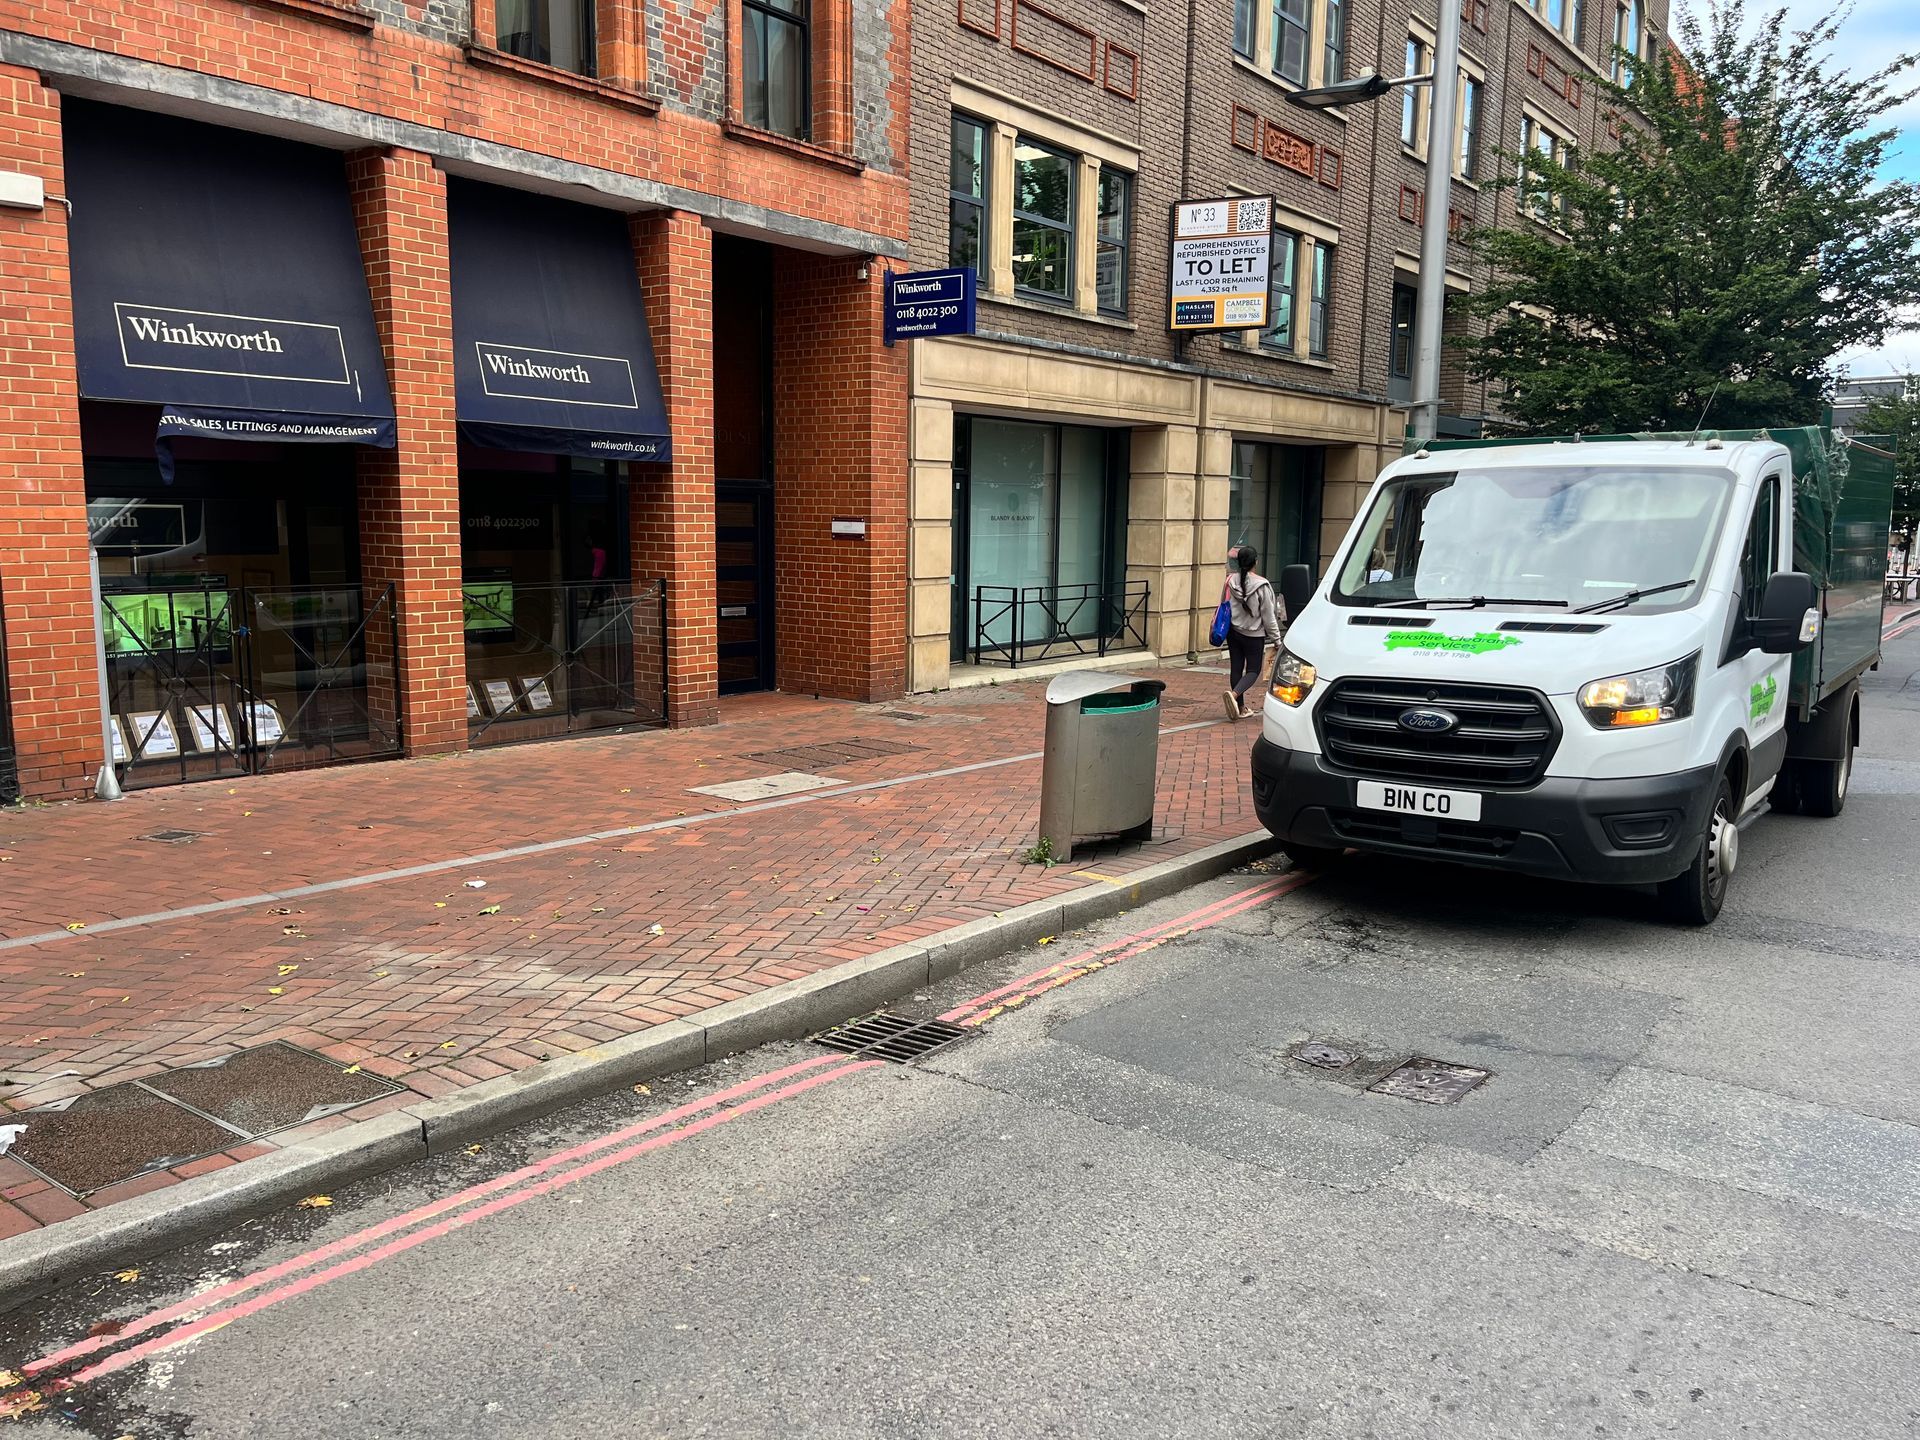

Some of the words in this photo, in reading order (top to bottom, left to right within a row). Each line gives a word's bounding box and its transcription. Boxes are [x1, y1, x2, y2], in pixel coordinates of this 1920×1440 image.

[1204, 207, 1216, 222] 33
[1176, 247, 1231, 259] REFURBISHED
[1232, 246, 1266, 255] OFFICES
[1183, 239, 1260, 251] COMPREHENSIVELY
[1185, 259, 1213, 276] TO
[1219, 257, 1257, 275] LET
[896, 280, 942, 294] Winkworth
[1175, 279, 1193, 287] LAST
[1195, 278, 1220, 286] FLOOR
[1221, 275, 1265, 285] REMAINING
[1201, 285, 1220, 293] 4,352
[1225, 299, 1262, 307] CAMPBELL
[896, 306, 915, 319] 0118
[916, 306, 938, 320] 4022
[939, 305, 958, 318] 300
[126, 315, 284, 353] Winkworth
[896, 322, 937, 332] winkworth.co.uk
[484, 352, 592, 384] Winkworth
[189, 418, 225, 432] SALES,
[226, 420, 277, 433] LETTINGS
[279, 424, 302, 434] AND
[304, 425, 378, 436] MANAGEMENT
[590, 439, 657, 454] winkworth.co.uk
[467, 515, 491, 528] 0118
[493, 517, 541, 530] 4022300
[1418, 640, 1477, 650] Services
[1449, 635, 1523, 646] Clearance
[1408, 712, 1440, 729] Ford
[1383, 787, 1417, 811] BIN
[1422, 792, 1451, 814] CO
